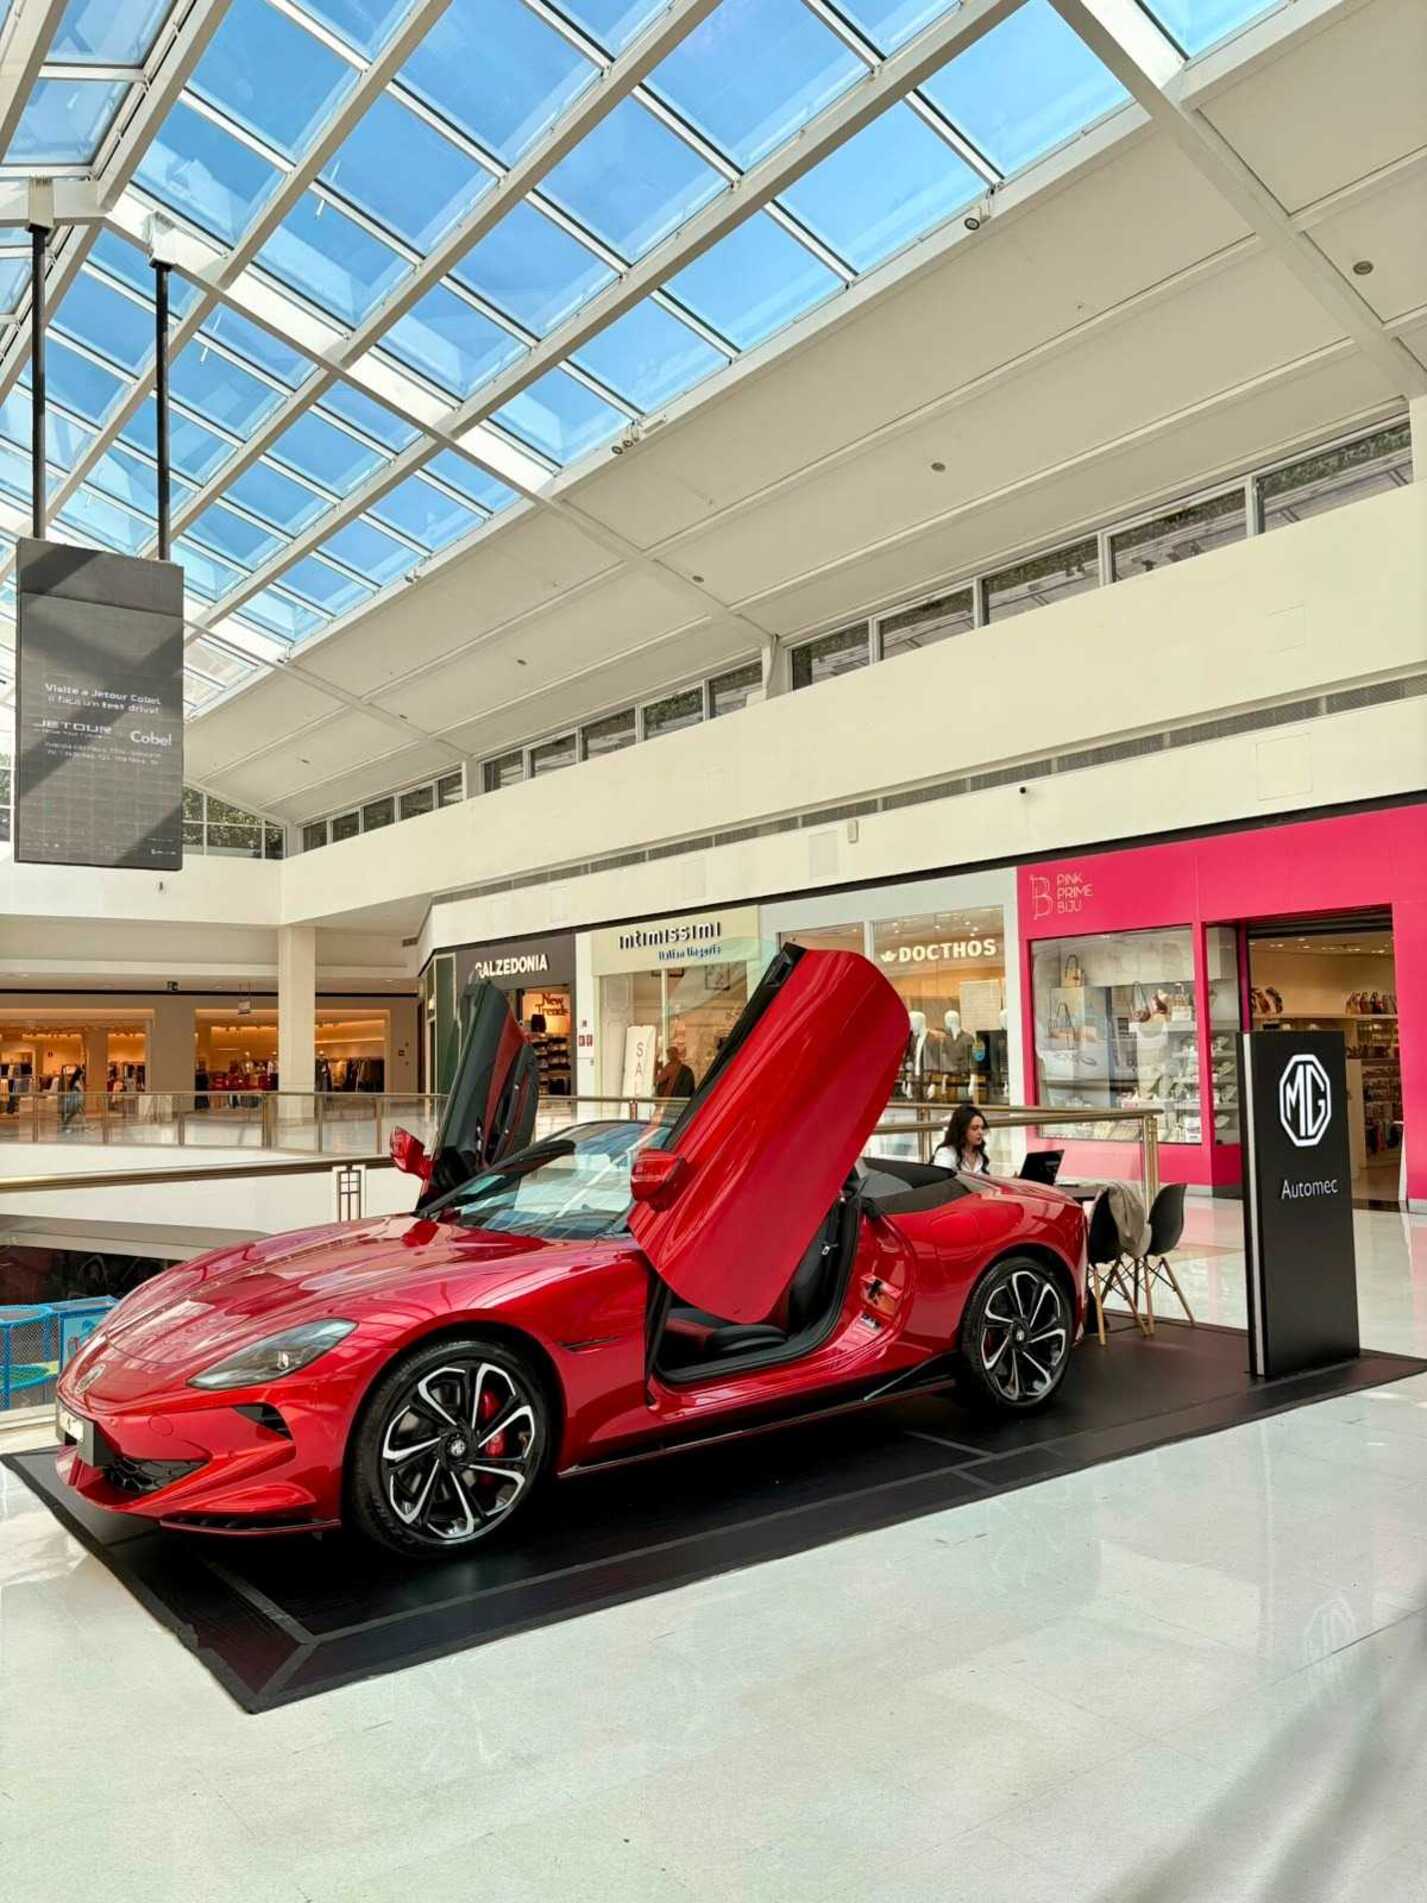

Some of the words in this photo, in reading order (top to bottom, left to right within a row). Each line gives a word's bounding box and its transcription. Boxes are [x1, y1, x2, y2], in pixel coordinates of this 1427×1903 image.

[45, 682, 80, 696] Visite
[92, 689, 128, 701] Jetour
[101, 700, 125, 711] test
[32, 719, 113, 735] JETOUR
[130, 730, 172, 746] Cobel
[1056, 872, 1084, 887] PINK
[1056, 883, 1094, 901] PRIME
[1056, 899, 1082, 914] BIJU
[898, 938, 998, 963] DOCTHOS
[475, 954, 549, 979] CALZEDONIA
[541, 991, 565, 1006] New
[1283, 1062, 1329, 1139] MG
[1280, 1178, 1339, 1201] Automec
